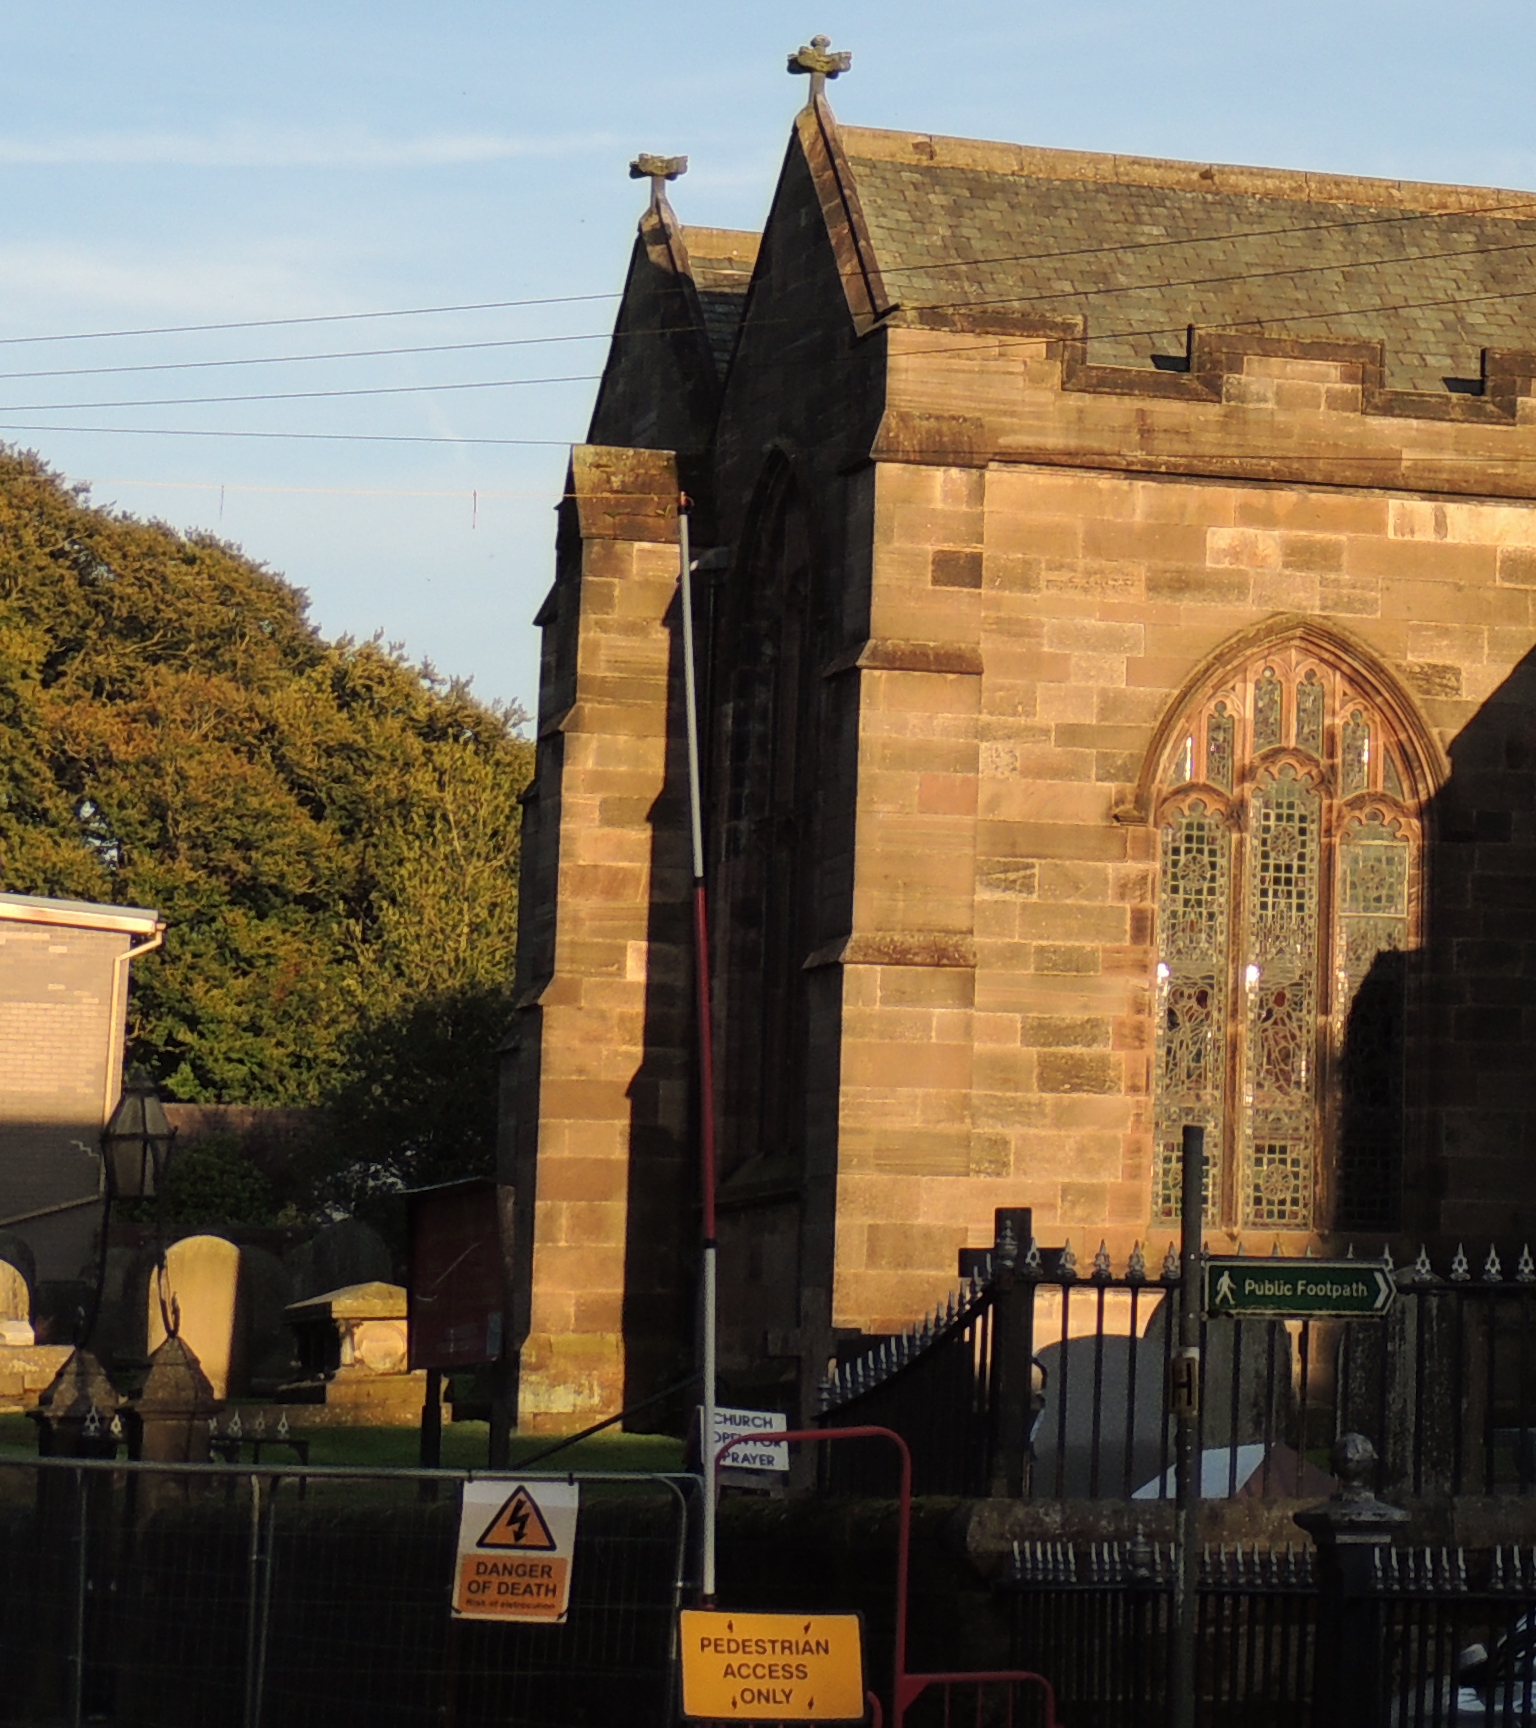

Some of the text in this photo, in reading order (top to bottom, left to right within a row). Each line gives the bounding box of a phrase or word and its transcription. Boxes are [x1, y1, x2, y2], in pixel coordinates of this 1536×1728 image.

[1245, 1278, 1368, 1299] Public Footpath
[714, 1413, 773, 1428] CHURCH
[722, 1451, 775, 1466] PRAYER
[476, 1561, 552, 1578] DANGER
[467, 1580, 557, 1597] OF DEATH
[700, 1637, 829, 1655] PEDESTRIAN
[723, 1663, 808, 1680] ACCESS
[740, 1688, 793, 1704] ONLY
